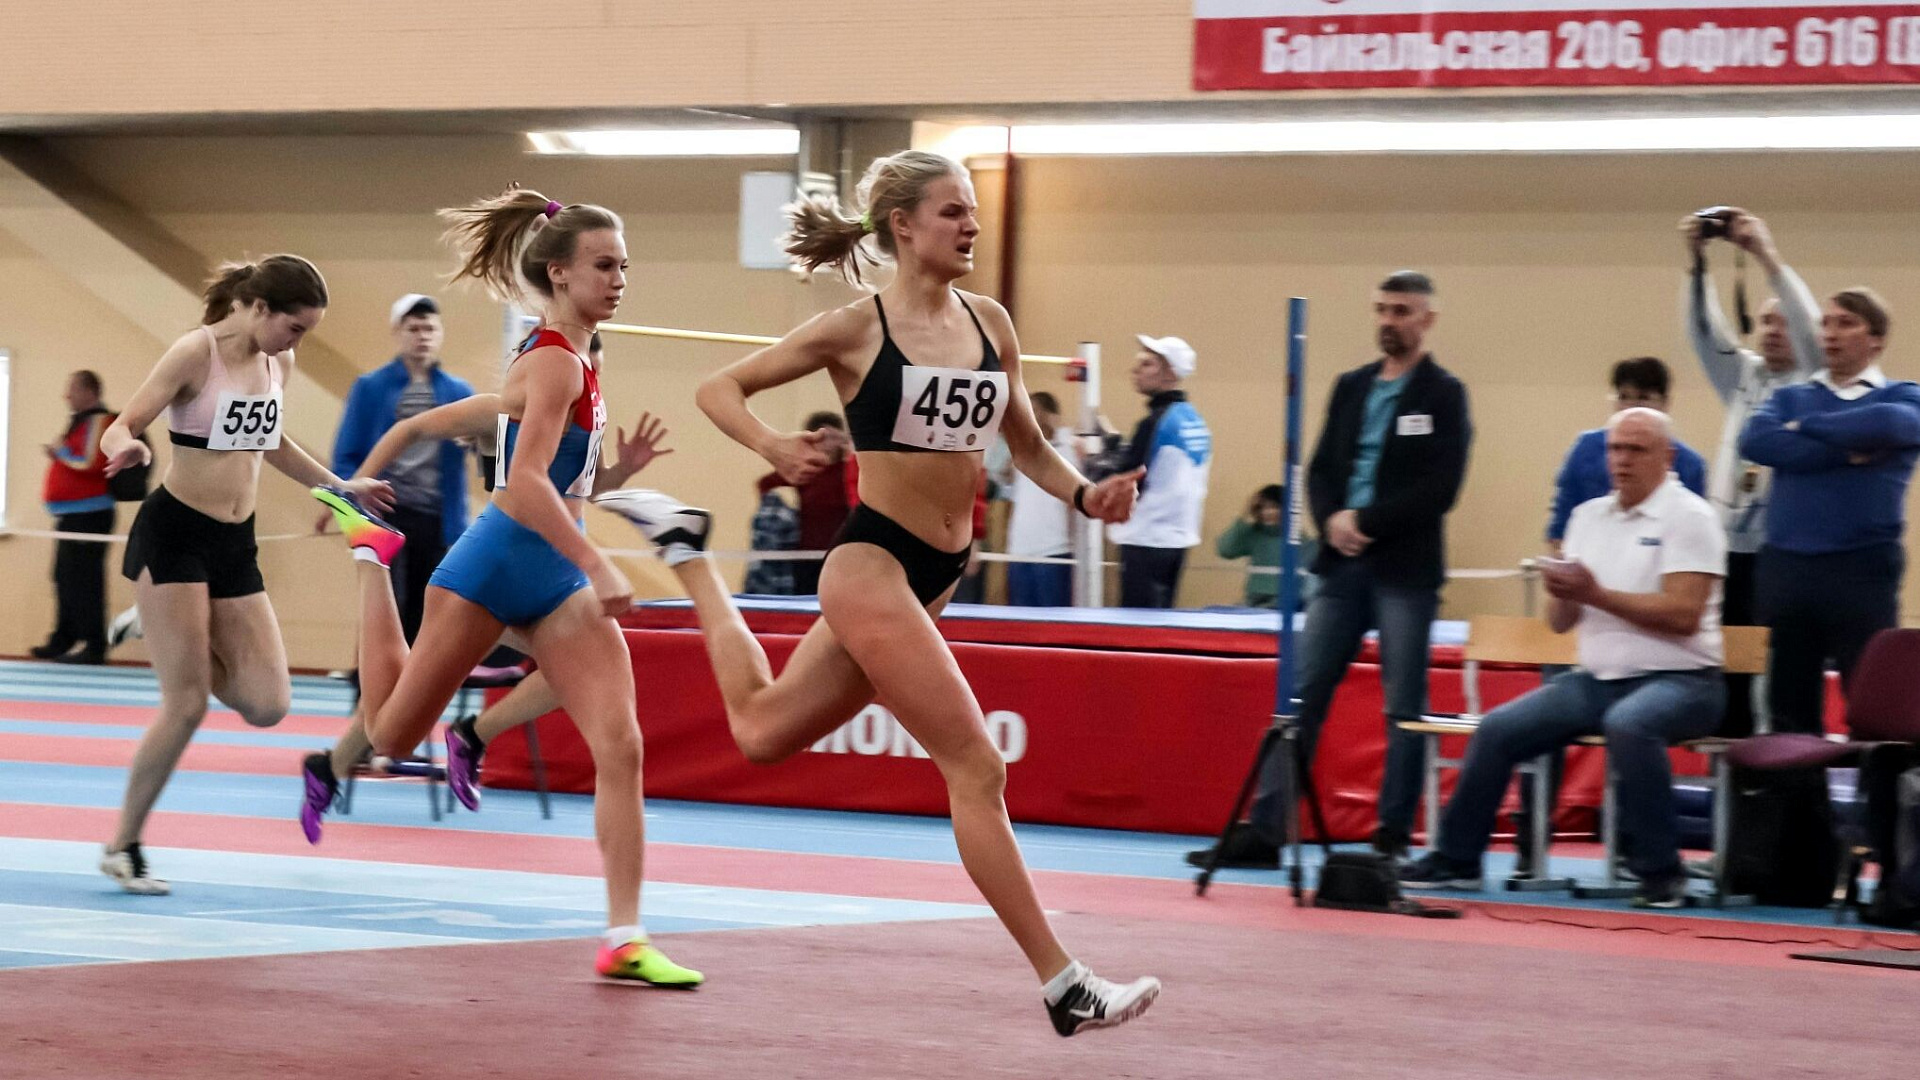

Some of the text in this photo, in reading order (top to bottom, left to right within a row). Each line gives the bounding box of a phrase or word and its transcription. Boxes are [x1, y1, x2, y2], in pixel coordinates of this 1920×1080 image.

[1262, 24, 1551, 73] Байкальская
[1555, 20, 1651, 72] 206,
[1657, 21, 1788, 73] офис
[1794, 17, 1879, 67] 616
[222, 399, 278, 435] 559
[912, 376, 997, 429] 458
